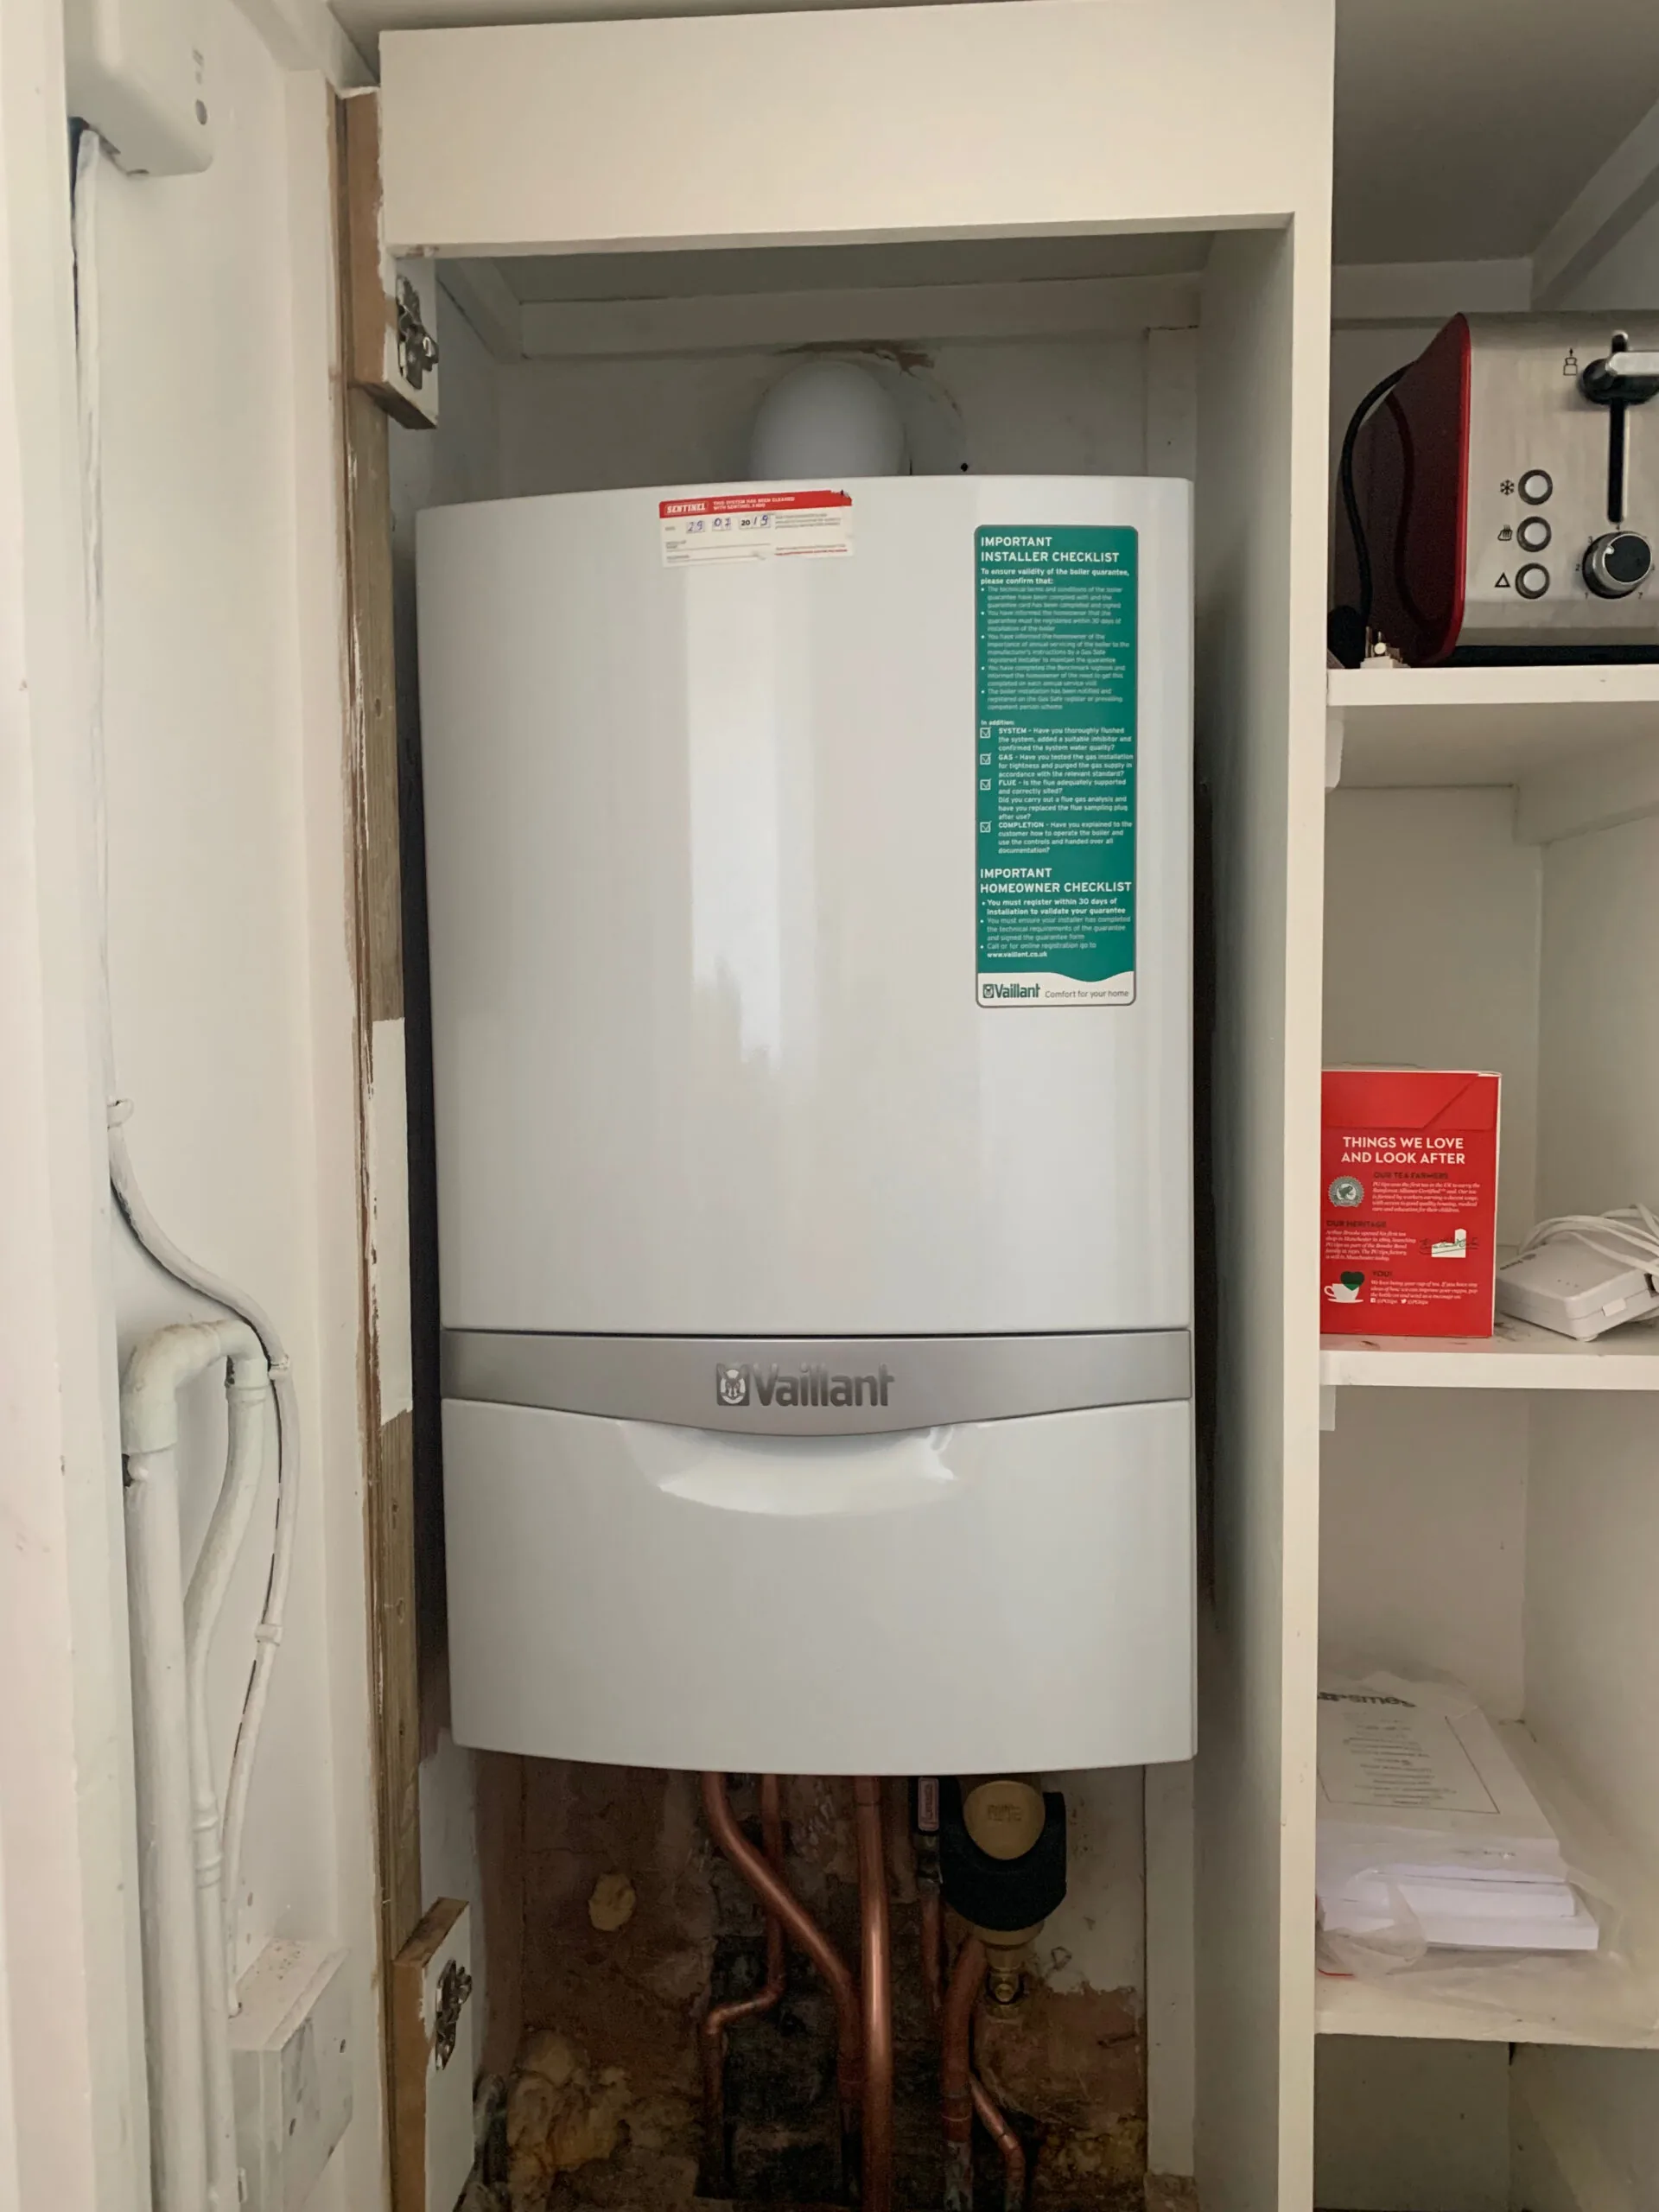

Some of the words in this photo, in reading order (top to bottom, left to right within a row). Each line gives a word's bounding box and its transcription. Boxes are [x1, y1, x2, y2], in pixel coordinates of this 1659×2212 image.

[667, 503, 705, 513] SENTINEL
[981, 537, 1052, 546] IMPORTANT
[981, 551, 1048, 562] INSTALLER
[1052, 552, 1120, 563] CHECKLIST
[980, 868, 1052, 878] IMPORTANT
[980, 883, 1060, 893] HOMEOWNER
[1064, 882, 1132, 892] CHECKLIST
[995, 983, 1040, 998] Vaillant
[1344, 1137, 1395, 1147] THINGS
[1400, 1137, 1422, 1148] WE
[1427, 1138, 1464, 1149] LOVE
[1341, 1152, 1371, 1162] AND
[1376, 1153, 1416, 1163] LOOK
[1421, 1153, 1465, 1164] AFTER
[753, 1363, 895, 1407] Vaillant
